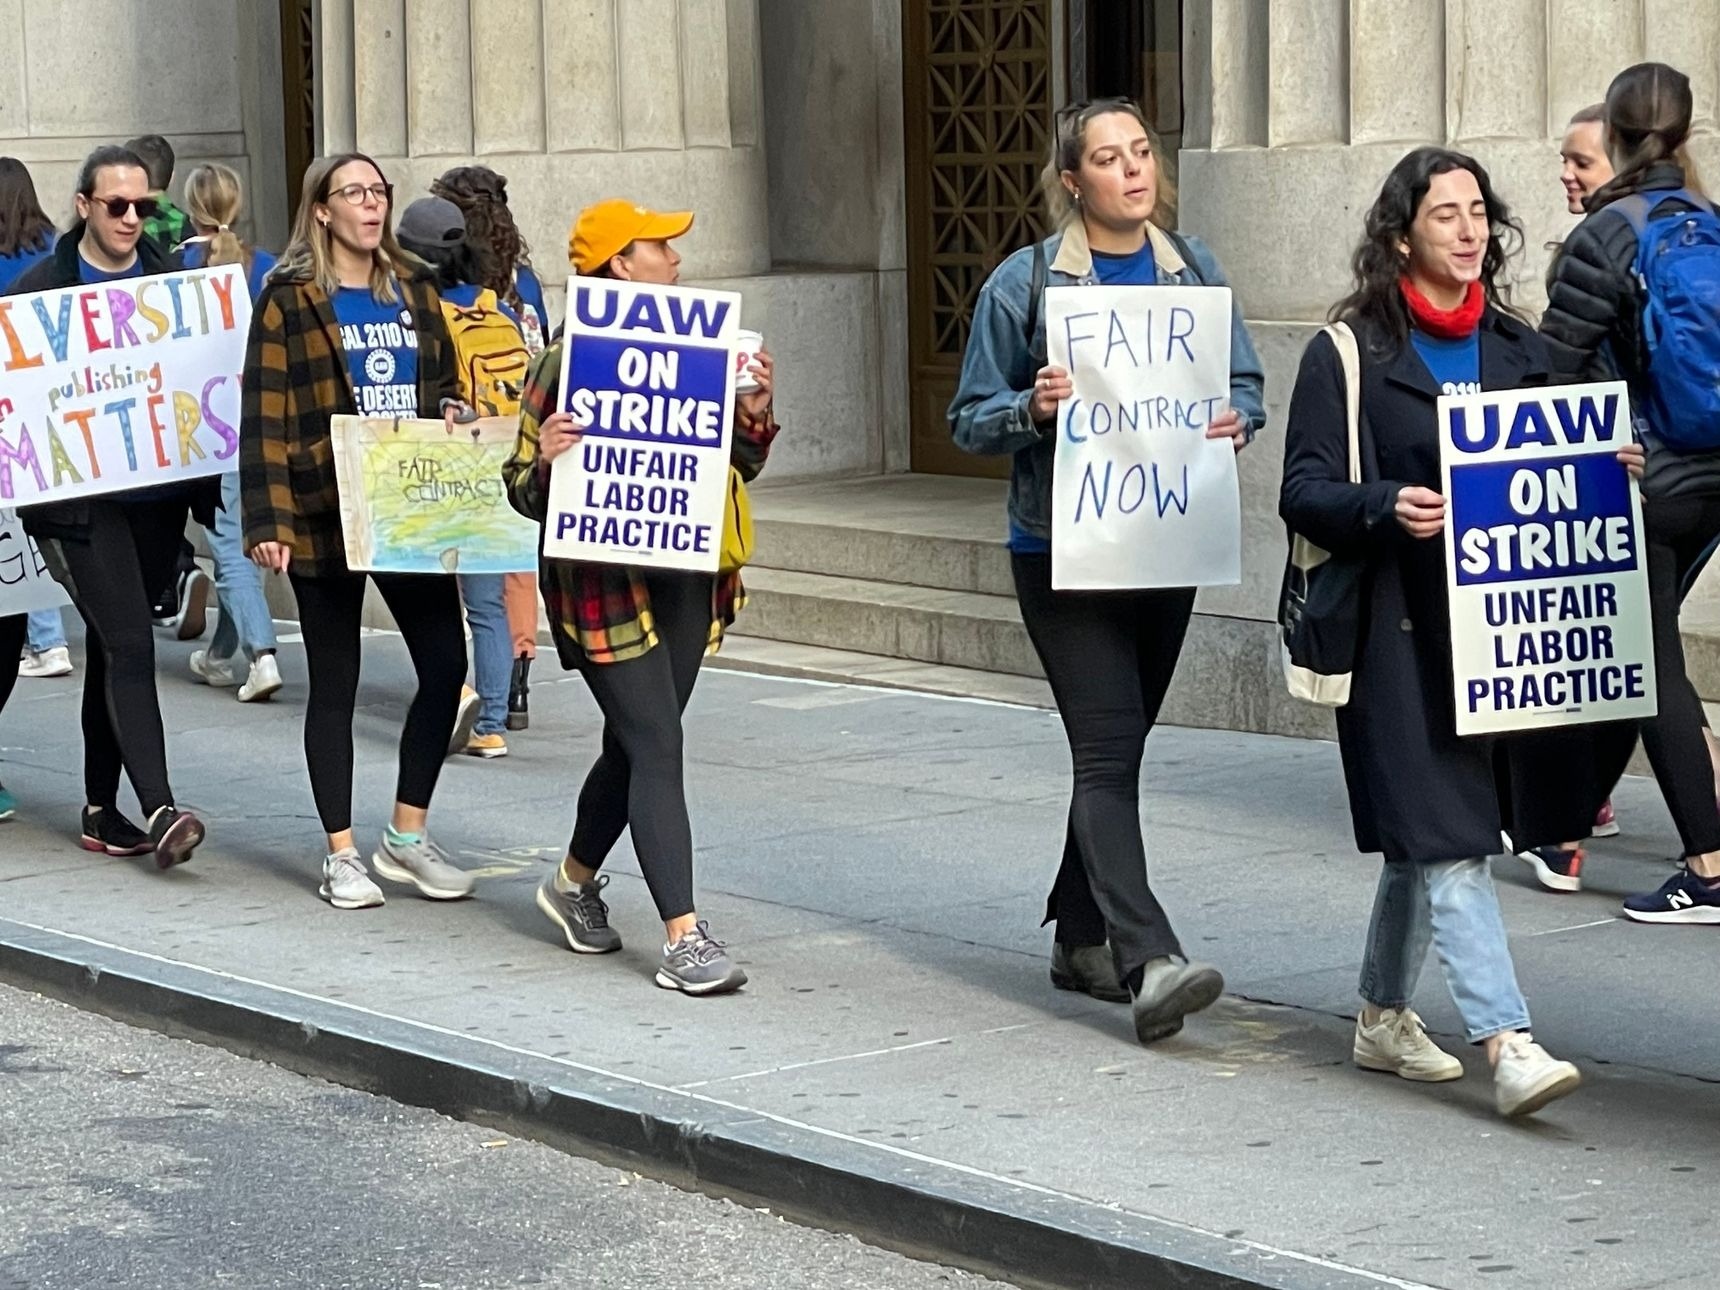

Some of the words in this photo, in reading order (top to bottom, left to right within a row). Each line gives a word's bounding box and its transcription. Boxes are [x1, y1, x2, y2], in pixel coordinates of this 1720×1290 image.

[364, 322, 402, 348] 2110
[576, 287, 731, 338] UAW
[1064, 307, 1195, 374] FAIR
[48, 362, 163, 412] publishing
[617, 346, 679, 390] ON
[0, 374, 243, 499] MATTERS
[570, 388, 721, 439] STRIKE
[1066, 396, 1224, 443] CONTRACT
[1449, 394, 1620, 453] UAW
[399, 457, 443, 483] FAIR
[582, 444, 698, 482] UNFAIR
[402, 478, 503, 502] CONTRACT
[585, 479, 689, 516] LABOR
[1074, 460, 1188, 523] NOW
[1509, 464, 1577, 515] ON
[556, 512, 711, 553] PRACTICE
[1460, 516, 1631, 575] STRIKE
[1484, 582, 1618, 627] UNFAIR
[1494, 624, 1614, 669] LABOR
[1467, 663, 1645, 713] PRACTICE
